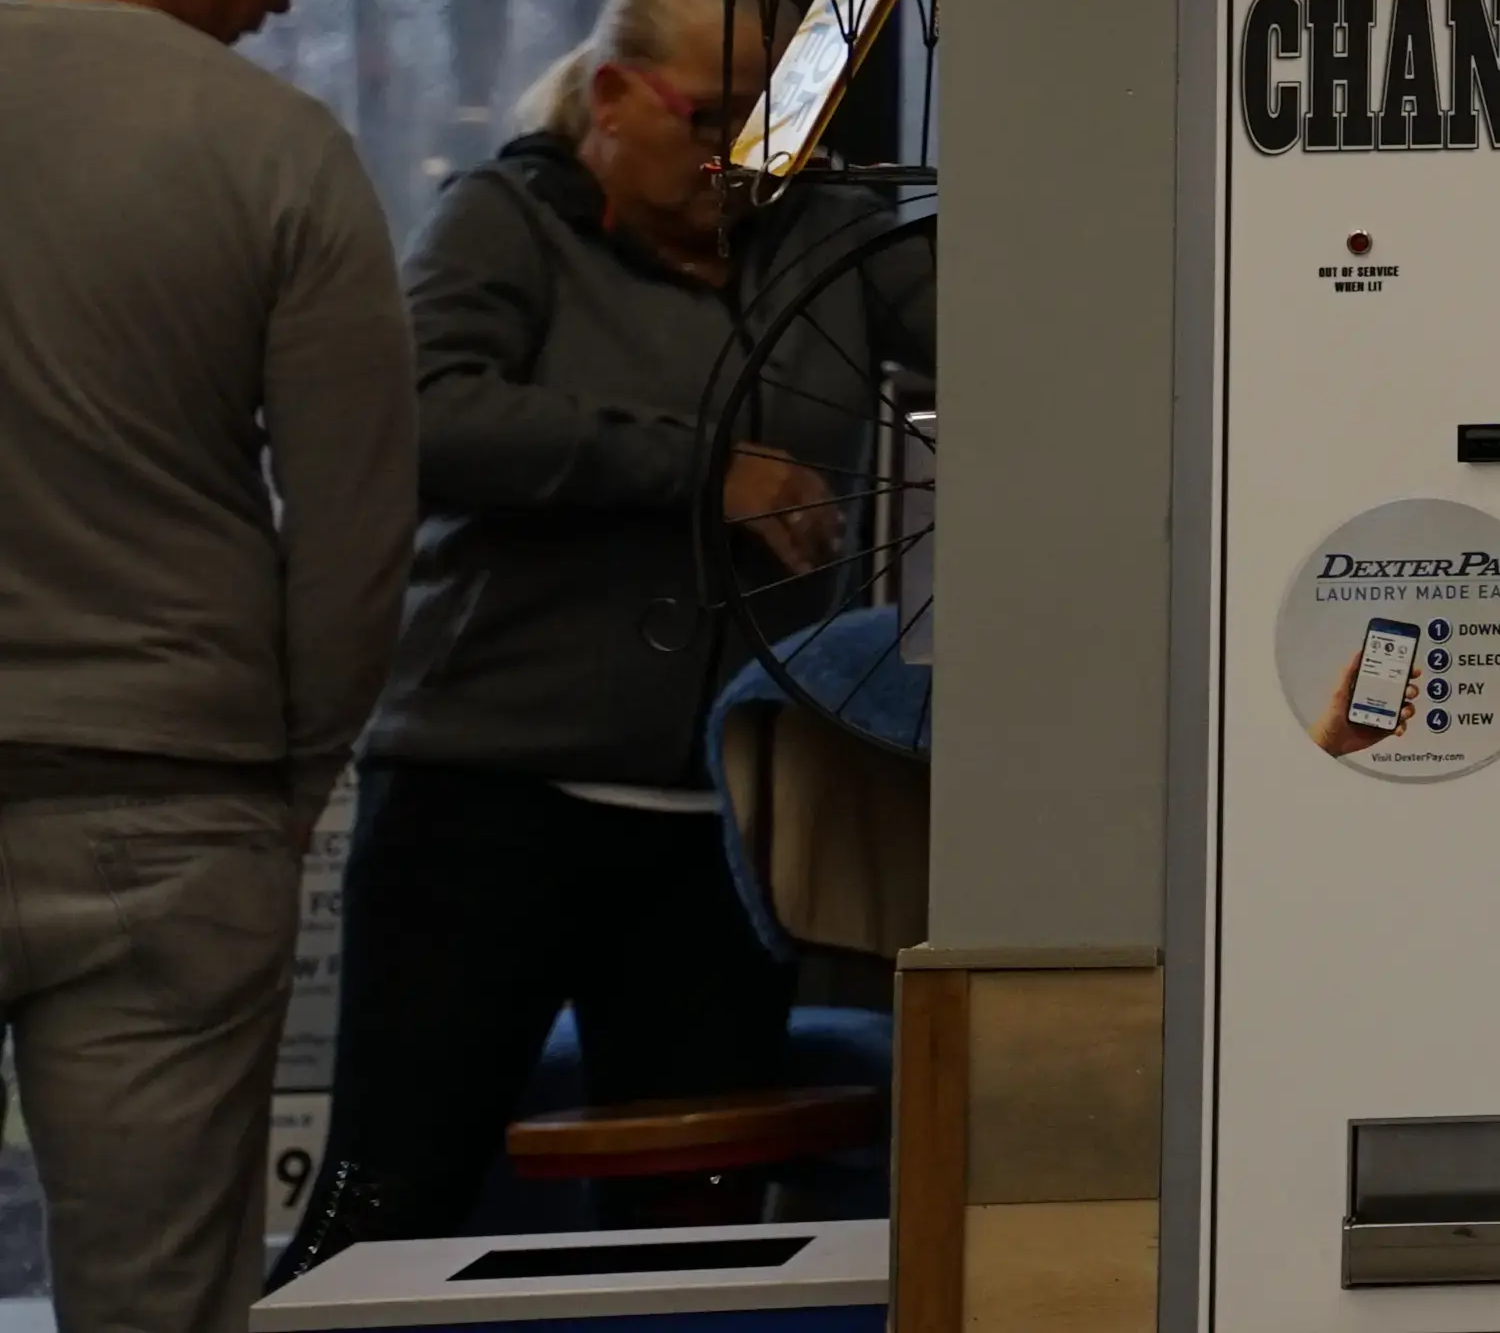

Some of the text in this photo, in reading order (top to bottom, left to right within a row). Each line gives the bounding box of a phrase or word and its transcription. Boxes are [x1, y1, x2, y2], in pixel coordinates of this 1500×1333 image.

[1318, 265, 1401, 279] OUT OF SERVICE
[1334, 280, 1384, 293] WHEN LIT
[1315, 584, 1408, 603] LAUNDRY
[1416, 583, 1470, 600] MADE
[1457, 682, 1485, 696] PAY
[1457, 711, 1494, 726] VIEW
[1371, 750, 1466, 764] Visit DexterPay.com
